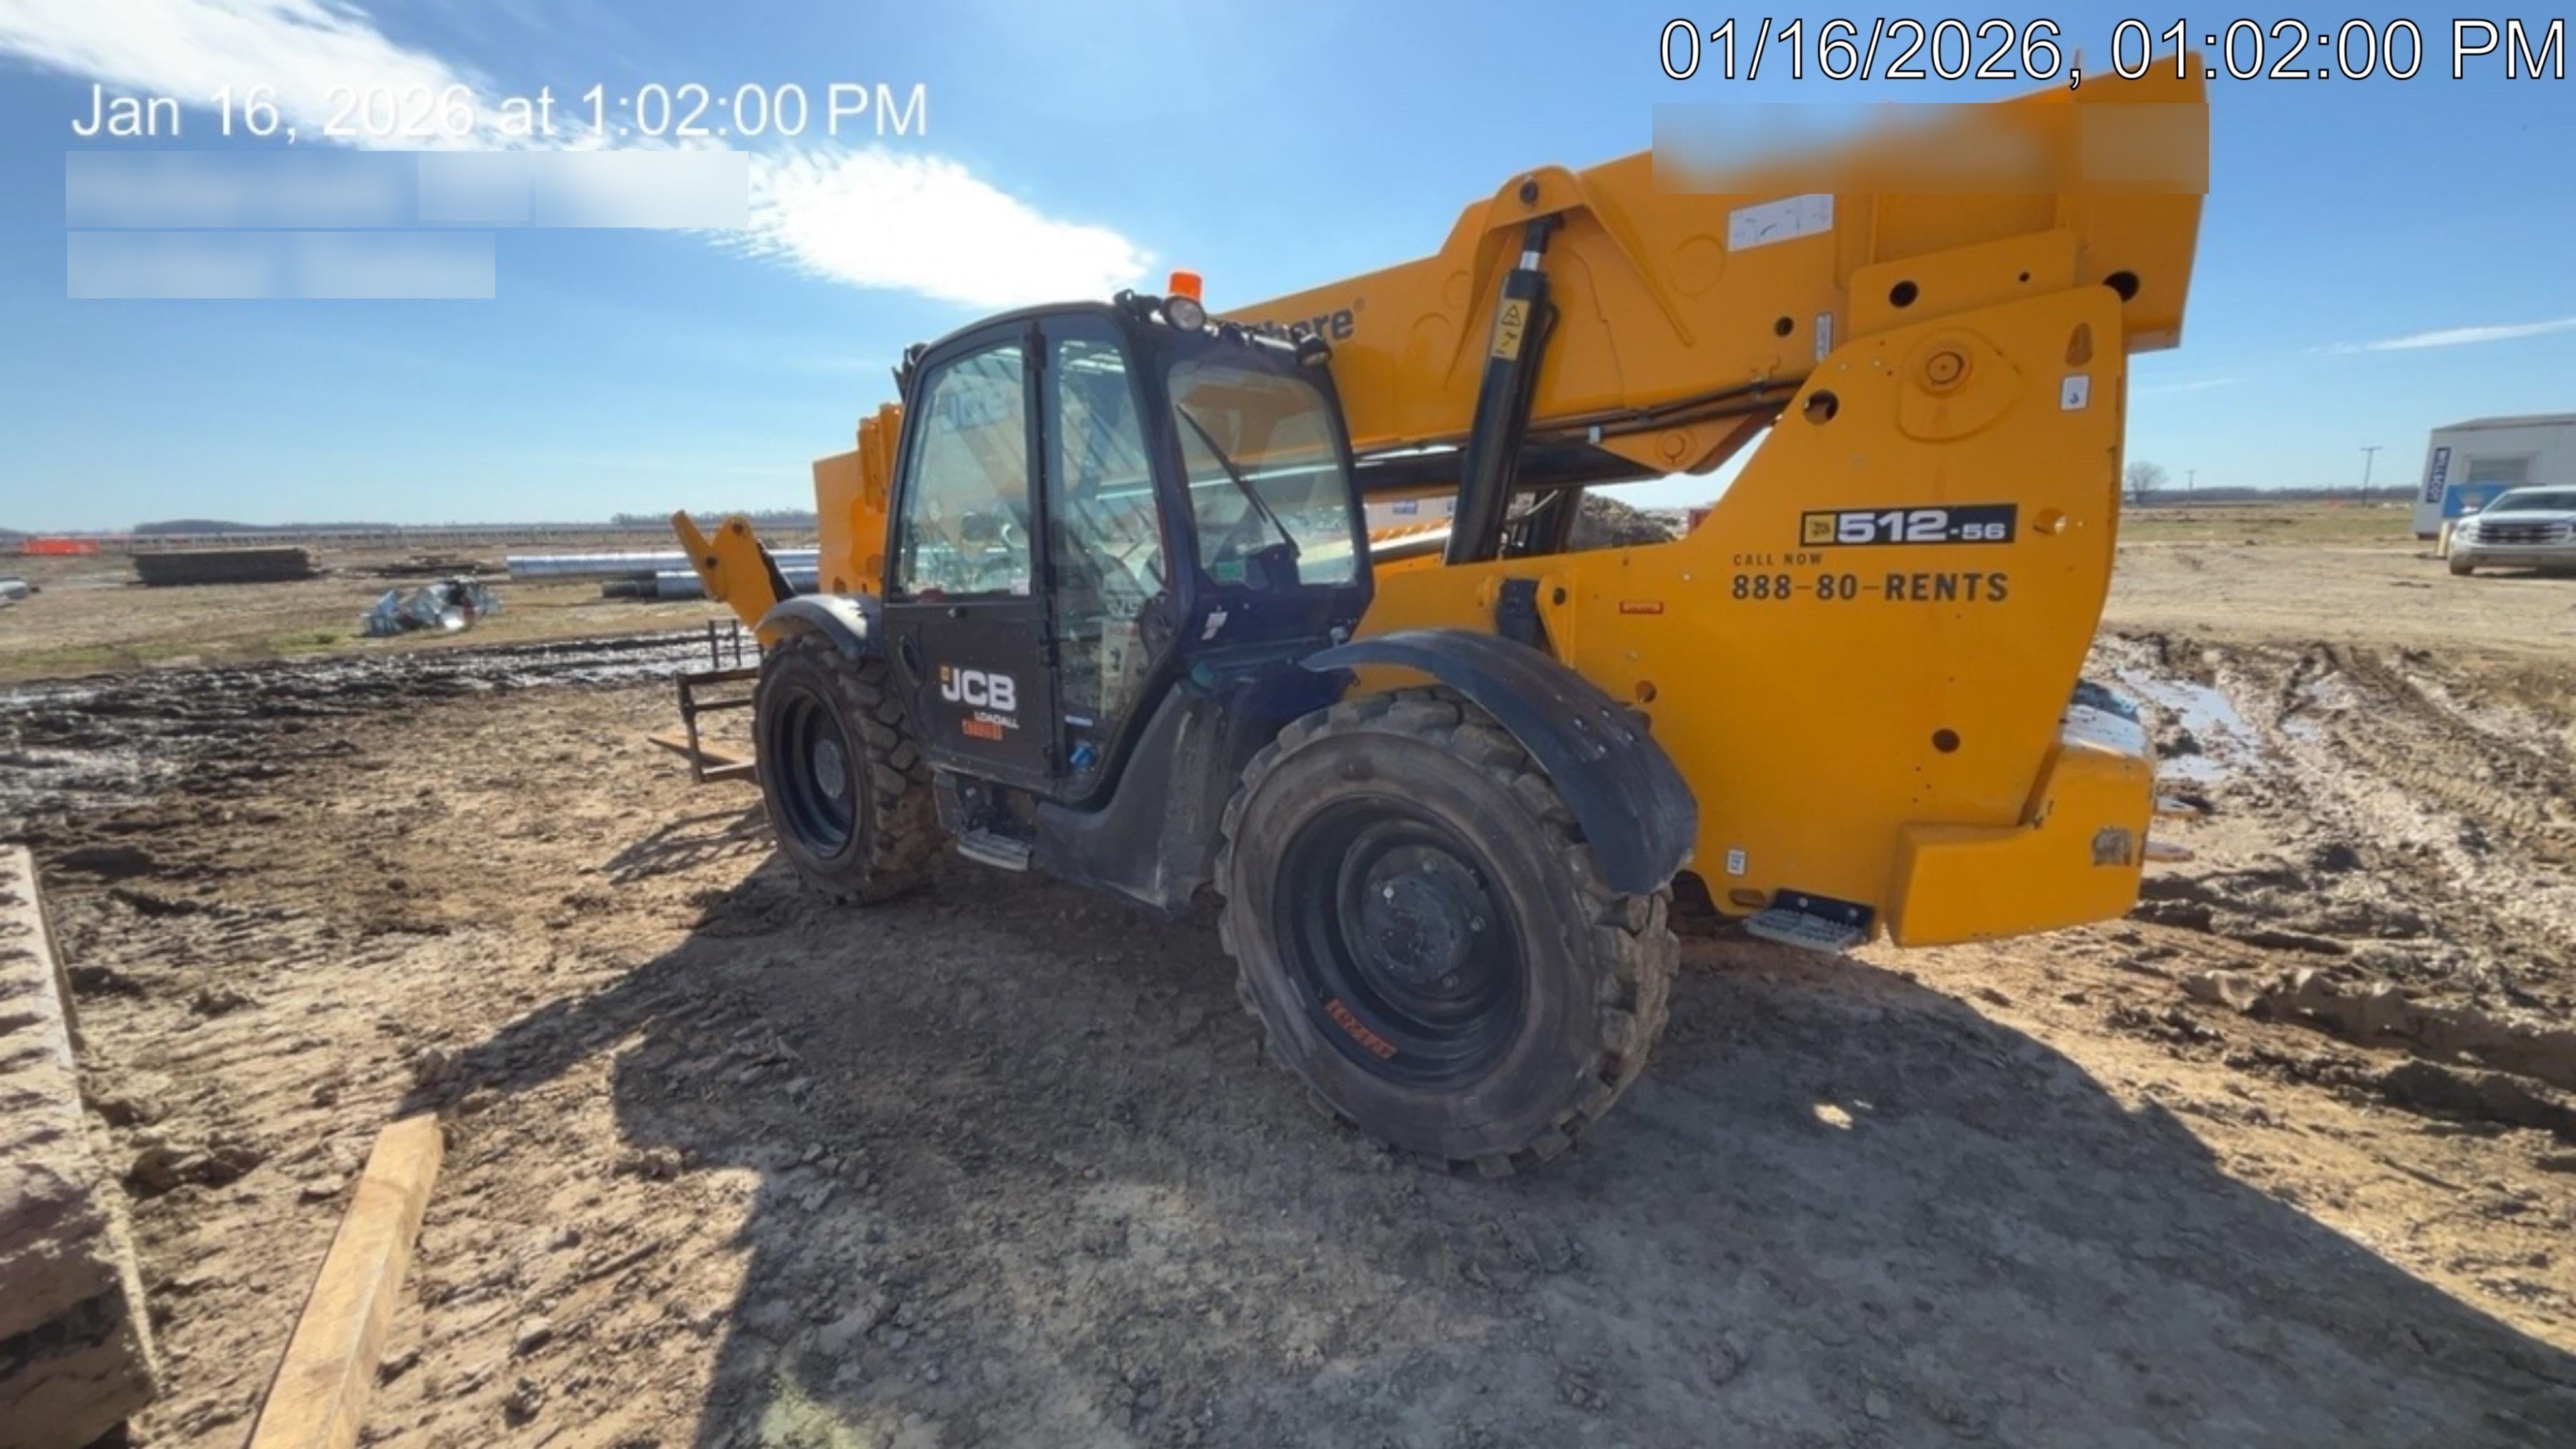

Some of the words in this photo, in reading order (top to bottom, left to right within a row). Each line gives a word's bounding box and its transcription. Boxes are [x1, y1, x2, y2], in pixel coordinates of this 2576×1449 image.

[1837, 509, 2006, 544] 512-56
[1733, 553, 1775, 566] CALL
[1783, 553, 1823, 565] NOW
[1732, 573, 2009, 602] 888-80-RENTS
[940, 667, 1016, 711] JCB
